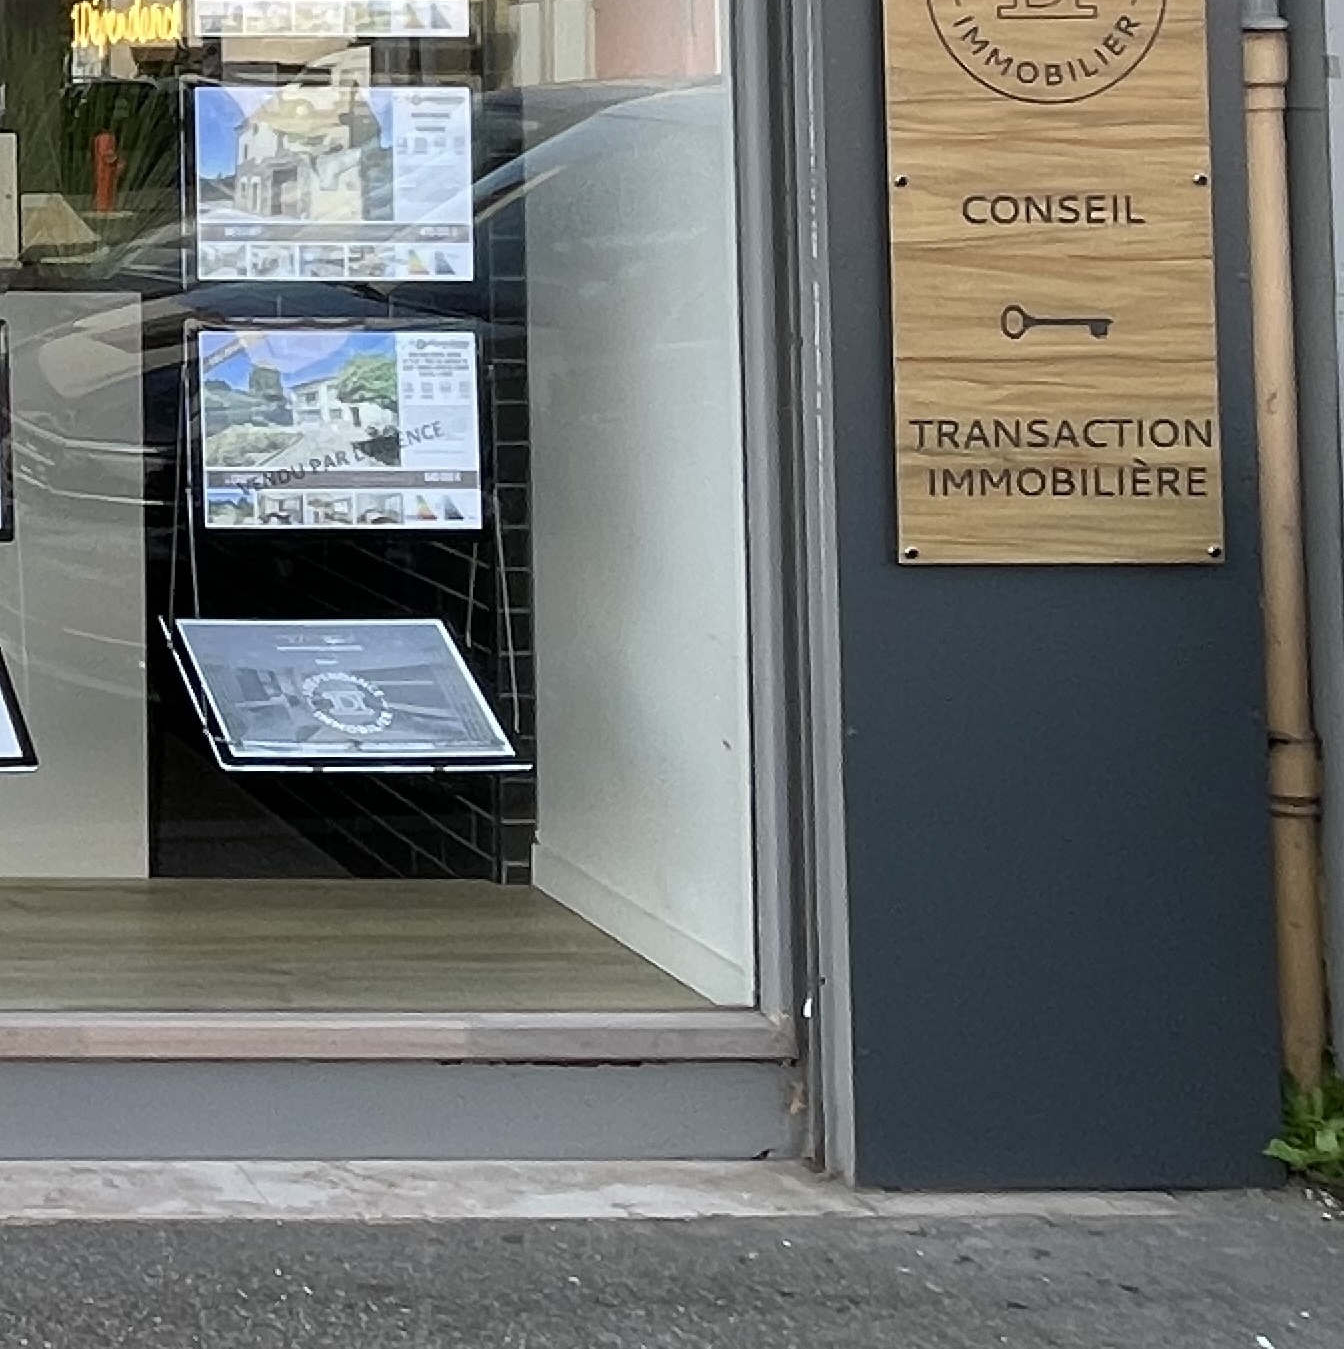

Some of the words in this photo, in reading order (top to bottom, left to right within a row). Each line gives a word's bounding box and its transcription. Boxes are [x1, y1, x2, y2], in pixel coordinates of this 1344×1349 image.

[953, 15, 1142, 86] IMMOBILIER
[962, 195, 1146, 224] CONSEIL
[908, 418, 1212, 450] TRANSACTION
[309, 451, 350, 473] PAR
[927, 458, 1209, 497] IMMOBILIÈRE
